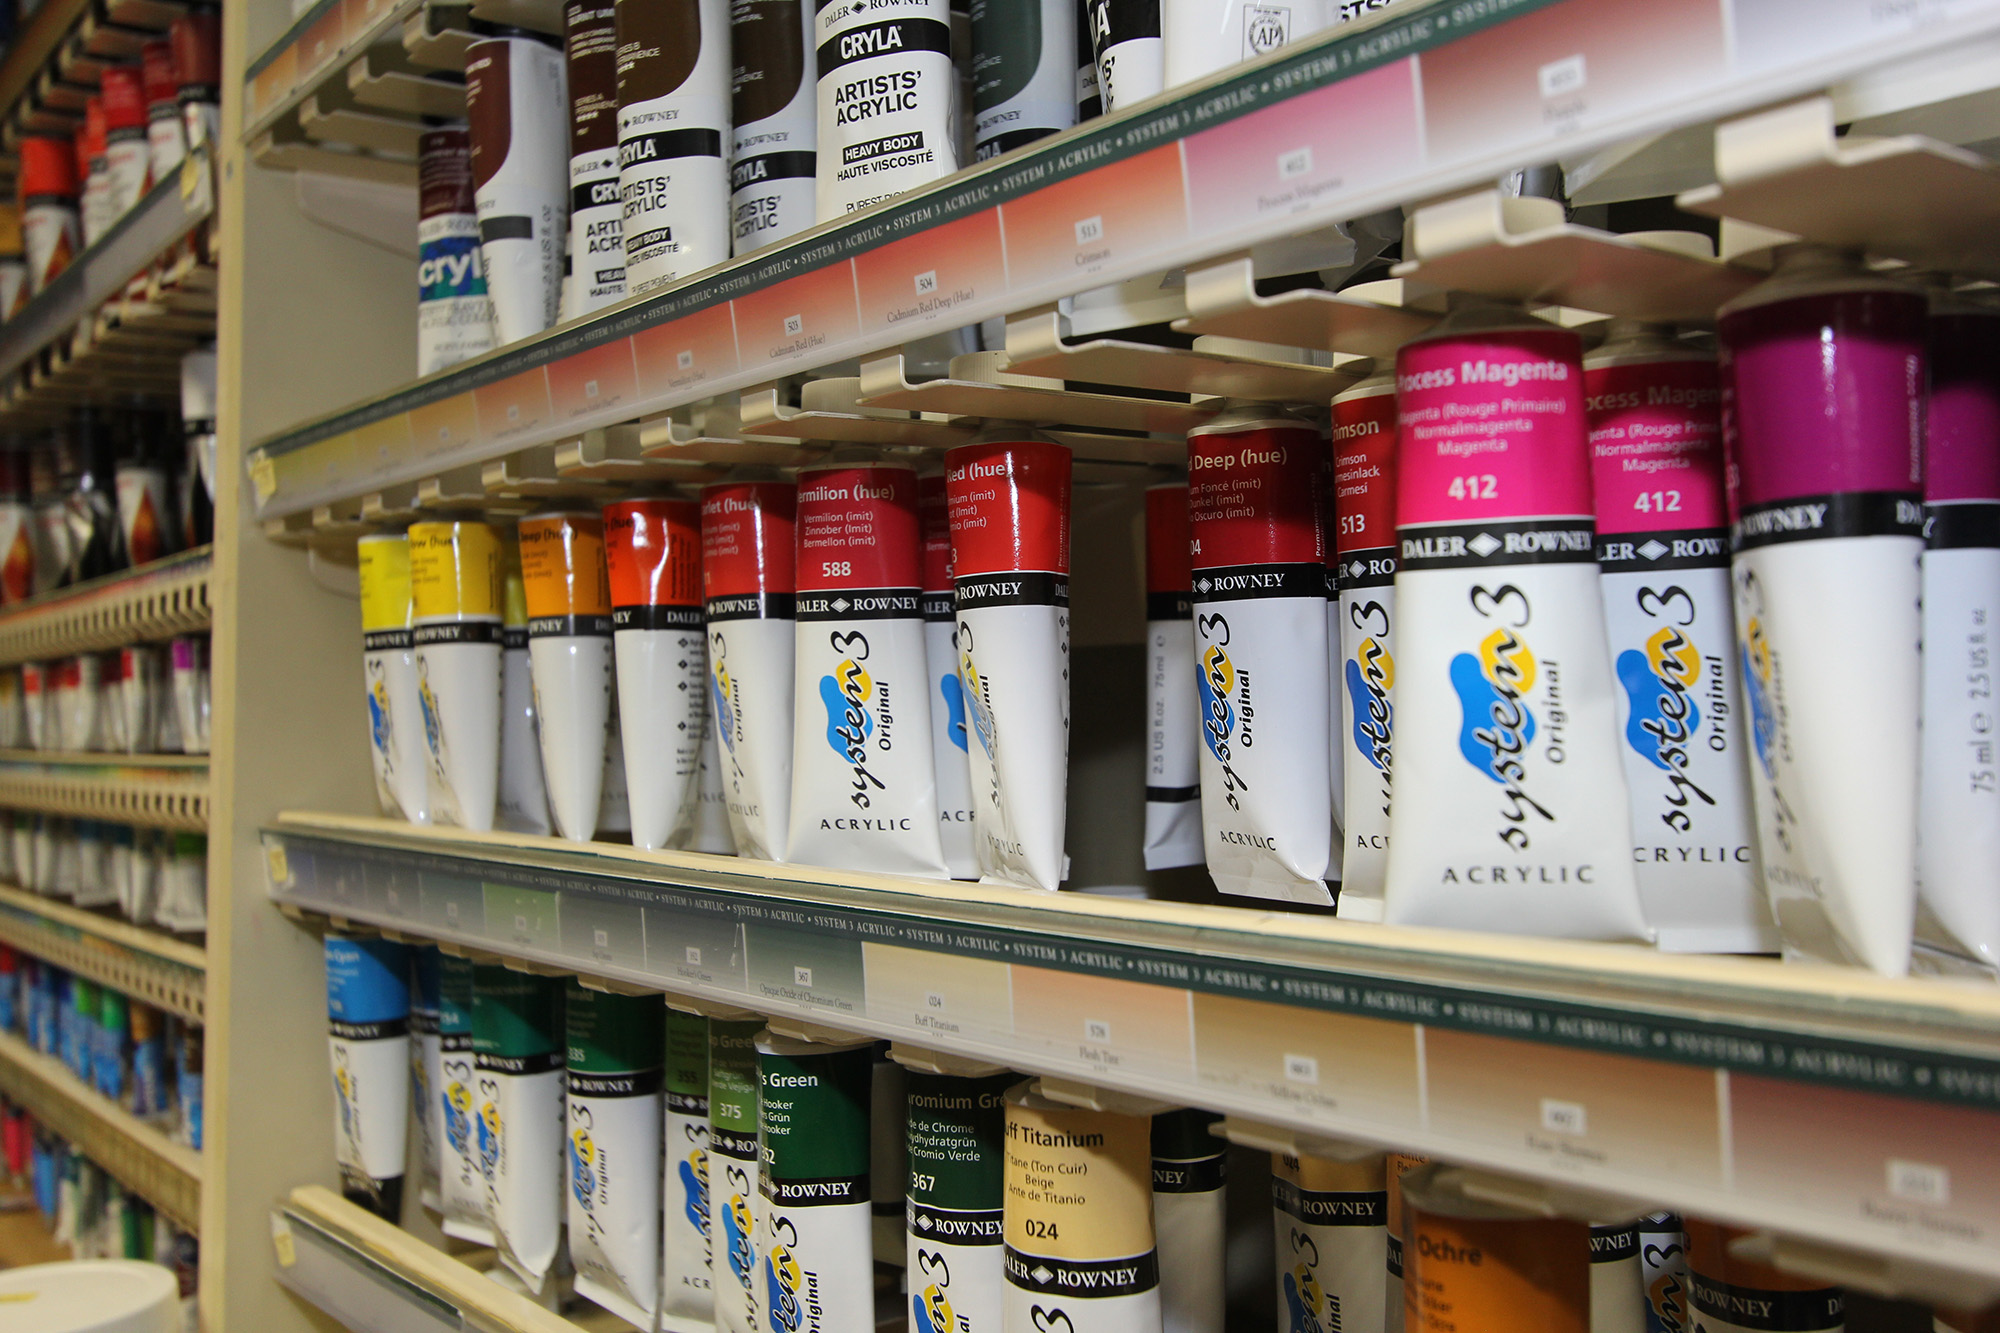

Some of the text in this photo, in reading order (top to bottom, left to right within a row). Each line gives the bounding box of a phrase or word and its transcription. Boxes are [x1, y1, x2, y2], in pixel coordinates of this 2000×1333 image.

[825, 6, 850, 28] DALER
[840, 25, 903, 60] CRYLA
[632, 109, 680, 127] ROWNEY
[836, 92, 918, 127] ACRYLIC
[844, 134, 920, 162] HEAVY BODY
[836, 149, 934, 182] HAUTE VISCOSITÉ
[719, 84, 1257, 294] SYSTEM 3 ACRYLIC SYSTEM 3 ACRYLIC SYSTEM 3 ACRYLIC SYSTEM 3 ACRYLIC SYSTEM 3 ACRYLIC
[644, 227, 669, 247] BODY
[1080, 223, 1098, 239] 513
[1074, 249, 1111, 266] Crimson
[919, 277, 933, 290] 504
[887, 287, 975, 323] Cadmium Red Deep (Hue)
[787, 320, 799, 332] 503
[795, 338, 808, 352] Red
[1461, 359, 1568, 387] Magenta
[1442, 402, 1497, 422] (Rouge
[1627, 421, 1682, 440] (Rouge
[1437, 436, 1509, 458] Magenta
[1194, 446, 1288, 471] Deep (hue)
[1336, 452, 1367, 469] Crimson
[1622, 456, 1691, 475] Magenta
[853, 484, 895, 502] (hue)
[1200, 477, 1262, 494] Foncé (imit)
[1337, 483, 1368, 498] Carmesí
[1447, 474, 1499, 501] 412
[969, 489, 996, 503] (imit)
[1216, 492, 1245, 506] (imit)
[1633, 490, 1682, 514] 412
[803, 511, 874, 524] Vermilion (imit)
[963, 516, 987, 530] (imit)
[1194, 505, 1255, 522] Oscuro (imit)
[804, 525, 842, 536] Zinnober
[1341, 513, 1366, 535] 513
[803, 535, 876, 549] Bermellon (imit)
[1402, 530, 1594, 559] DALER ROWNEY
[822, 561, 852, 578] 588
[960, 581, 1023, 600] ROWNEY
[1213, 572, 1286, 592] ROWNEY
[852, 597, 919, 611] ROWNEY
[1351, 599, 1390, 638] 3
[730, 678, 744, 743] Original
[1198, 612, 1248, 813] system 3
[1236, 668, 1255, 748] Original
[1539, 659, 1570, 765] Original
[1636, 584, 1718, 835] system 3
[1704, 655, 1730, 752] Original
[829, 630, 886, 811] system 3
[875, 681, 894, 752] Original
[1469, 583, 1556, 852] system 3
[1153, 730, 1165, 750] US
[1968, 738, 1994, 765] ml
[1969, 770, 1995, 794] 75
[820, 818, 912, 831] ACRYLIC
[1220, 829, 1277, 852] ACRYLIC
[1632, 845, 1751, 863] CRYLIC
[1441, 864, 1596, 884] ACRYLIC
[661, 892, 1268, 993] SYSTEM 3 ACRYLIC SYSTEM 3 ACRYLIC SYSTEM 3 ACRYLIC SYSTEM 3 ACRYLIC SYSTEM 3 ACRYLIC SYSTEM 3 ACRYLIC
[928, 996, 942, 1009] 024
[914, 1012, 960, 1033] Buff Titanium
[769, 1072, 819, 1088] Green
[719, 1102, 742, 1120] 375
[768, 1112, 791, 1123] Grün
[931, 1121, 975, 1135] Chrome
[1020, 1125, 1105, 1149] Titanium
[913, 1147, 981, 1162] Cromio Verde
[1030, 1160, 1055, 1174] (Ton
[1057, 1161, 1088, 1176] Cuir)
[780, 1181, 852, 1199] ROWNEY
[912, 1171, 936, 1192] 367
[1024, 1173, 1055, 1190] Beige
[1008, 1183, 1086, 1206] Ante de Titanio
[1302, 1201, 1376, 1217] ROWNEY
[935, 1217, 1004, 1236] ROWNEY
[1025, 1218, 1059, 1241] 024
[1416, 1232, 1486, 1268] Ochre
[1056, 1267, 1138, 1289] ROWNEY
[1695, 1281, 1774, 1319] ROWNEY
